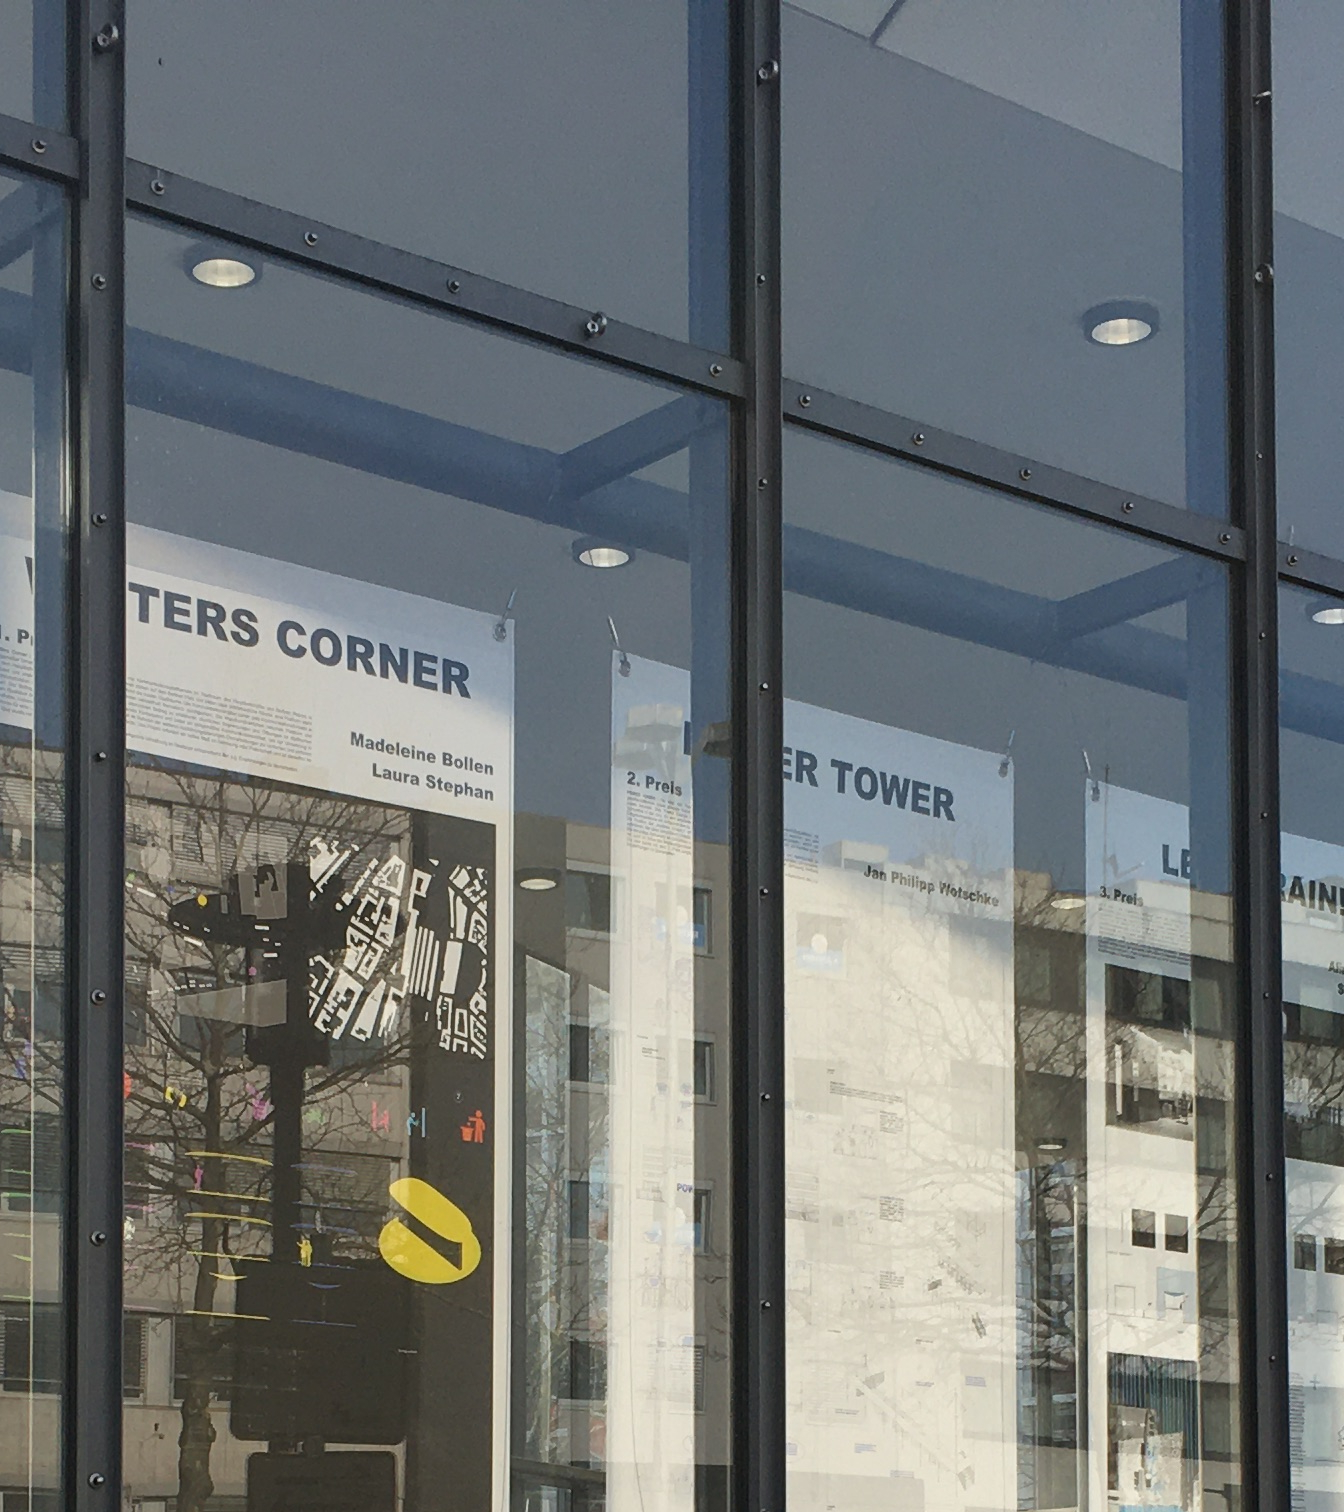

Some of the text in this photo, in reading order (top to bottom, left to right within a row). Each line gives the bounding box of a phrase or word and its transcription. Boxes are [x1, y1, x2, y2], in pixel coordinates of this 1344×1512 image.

[275, 619, 472, 701] CORNER
[349, 730, 495, 777] Madeleine Bollen
[371, 761, 495, 803] Laura Stephan
[626, 770, 683, 797] 2. Preis
[831, 758, 956, 822] TOWER
[863, 863, 887, 882] Jan
[891, 870, 935, 894] Philipp
[1099, 885, 1143, 907] 3. Preis
